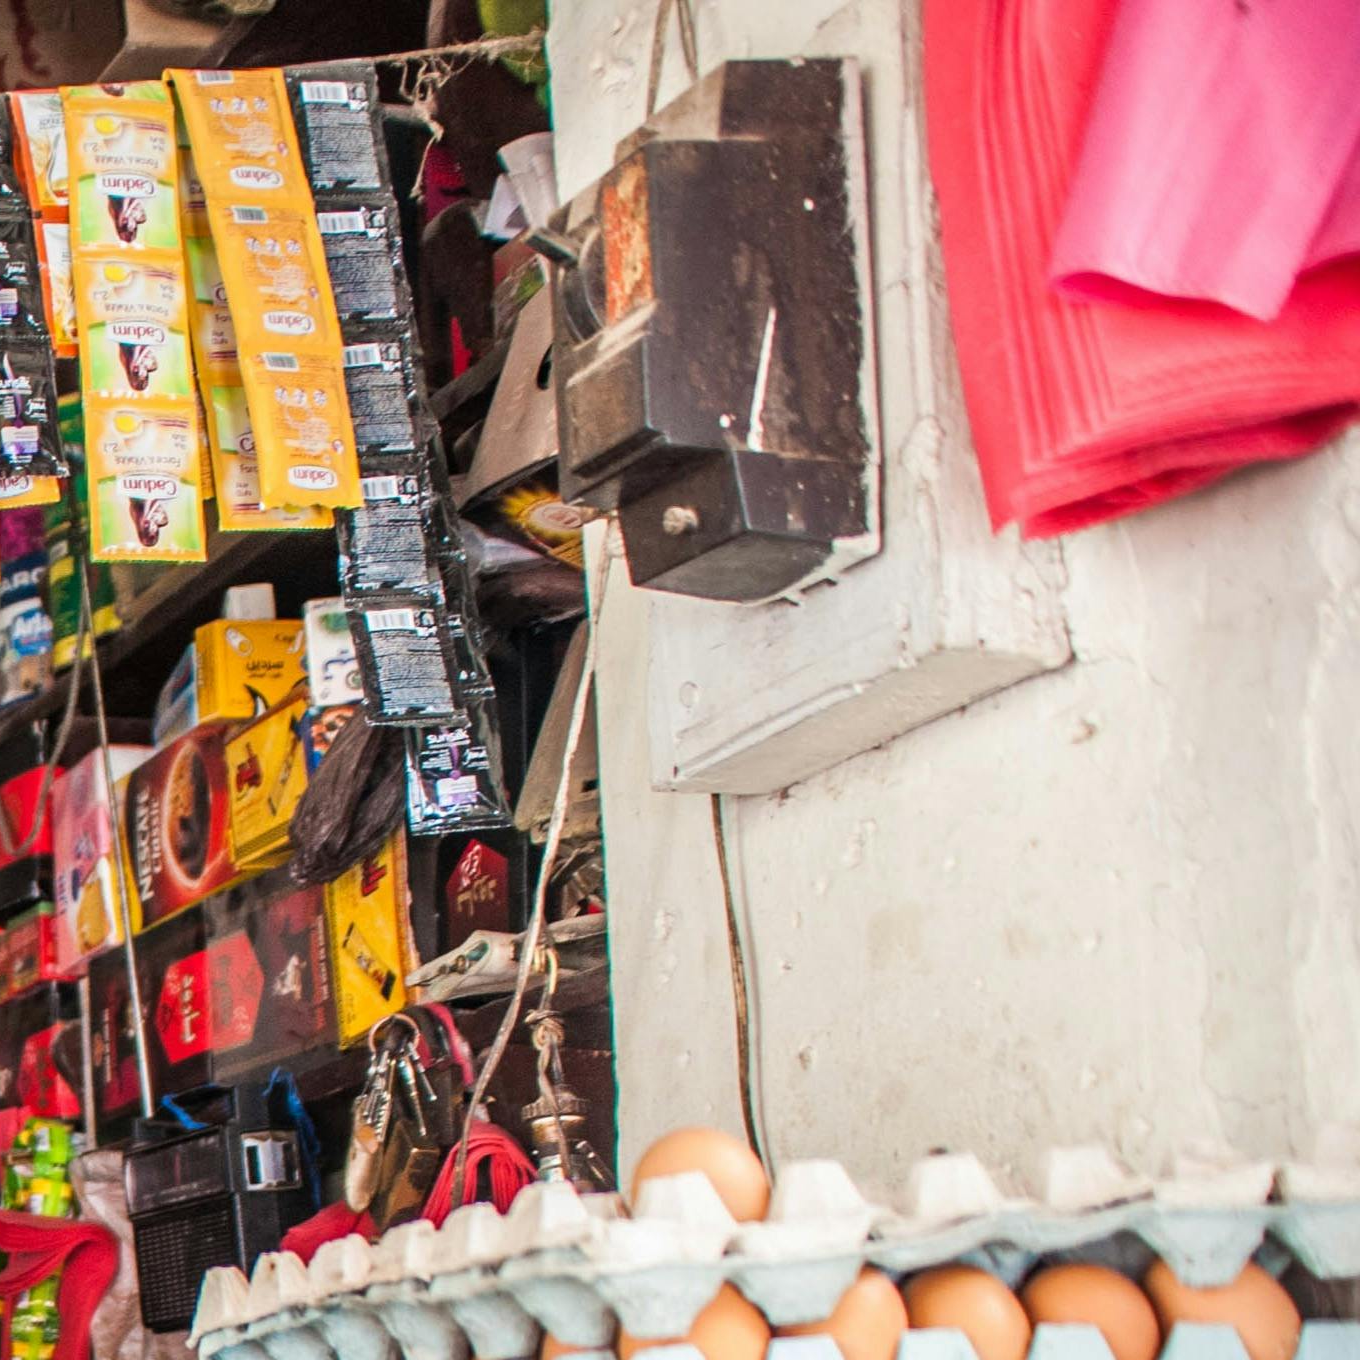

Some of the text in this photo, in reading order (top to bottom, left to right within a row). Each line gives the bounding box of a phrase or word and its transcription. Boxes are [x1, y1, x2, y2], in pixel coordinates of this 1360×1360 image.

[102, 176, 155, 196] Cadum
[112, 325, 166, 343] Cadum
[123, 477, 177, 496] Cadum
